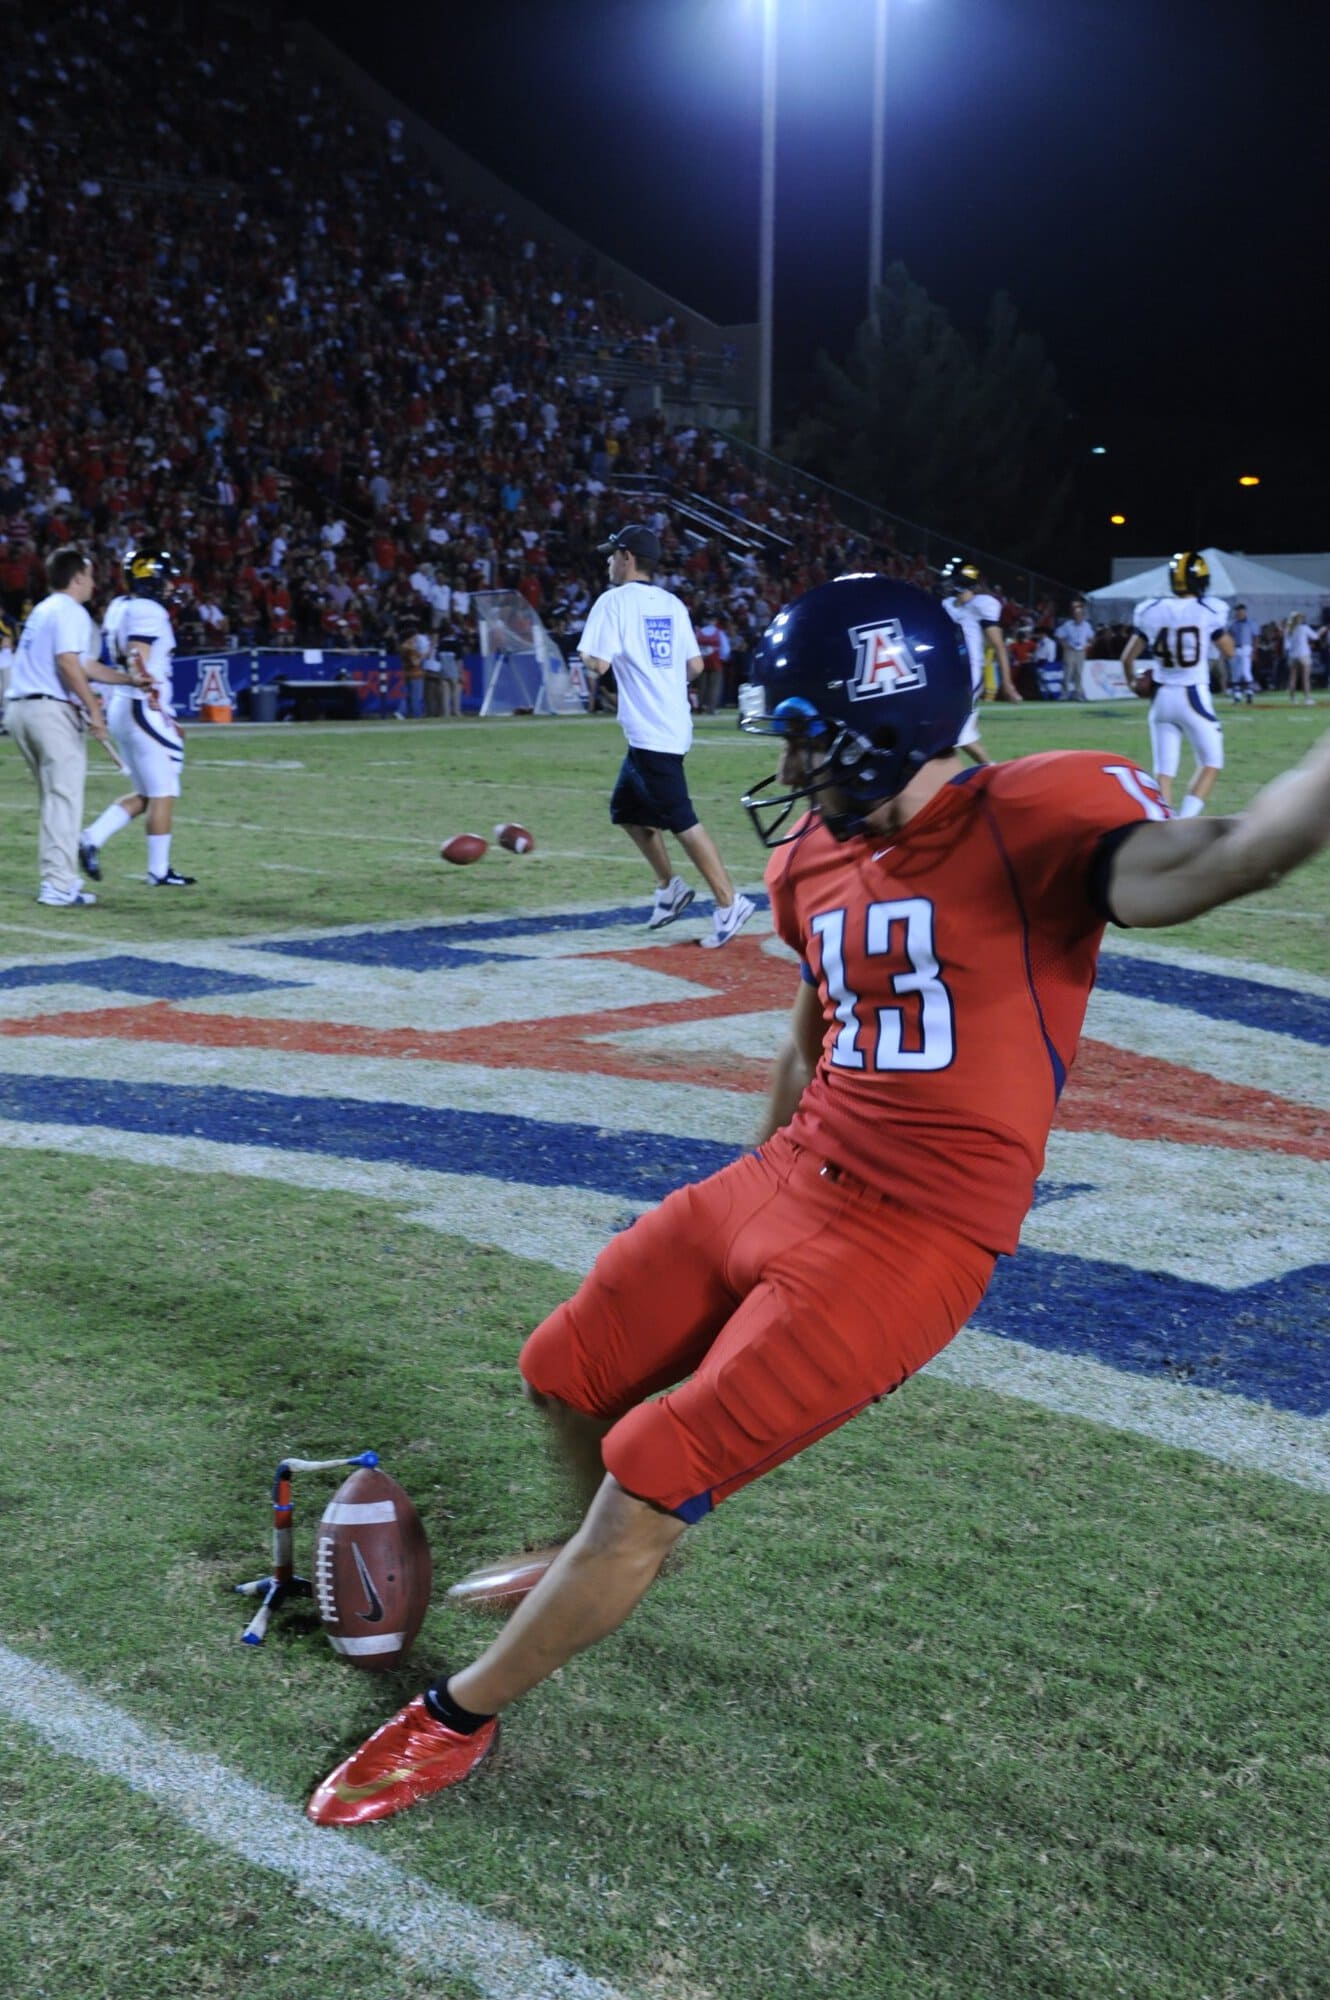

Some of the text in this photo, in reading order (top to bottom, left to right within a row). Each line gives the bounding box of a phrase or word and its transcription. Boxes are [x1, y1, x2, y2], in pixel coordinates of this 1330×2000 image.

[648, 630, 670, 640] PAC
[650, 641, 671, 658] 10
[1152, 626, 1200, 668] 40
[847, 618, 927, 702] A
[191, 660, 236, 709] A
[810, 896, 957, 1072] 13
